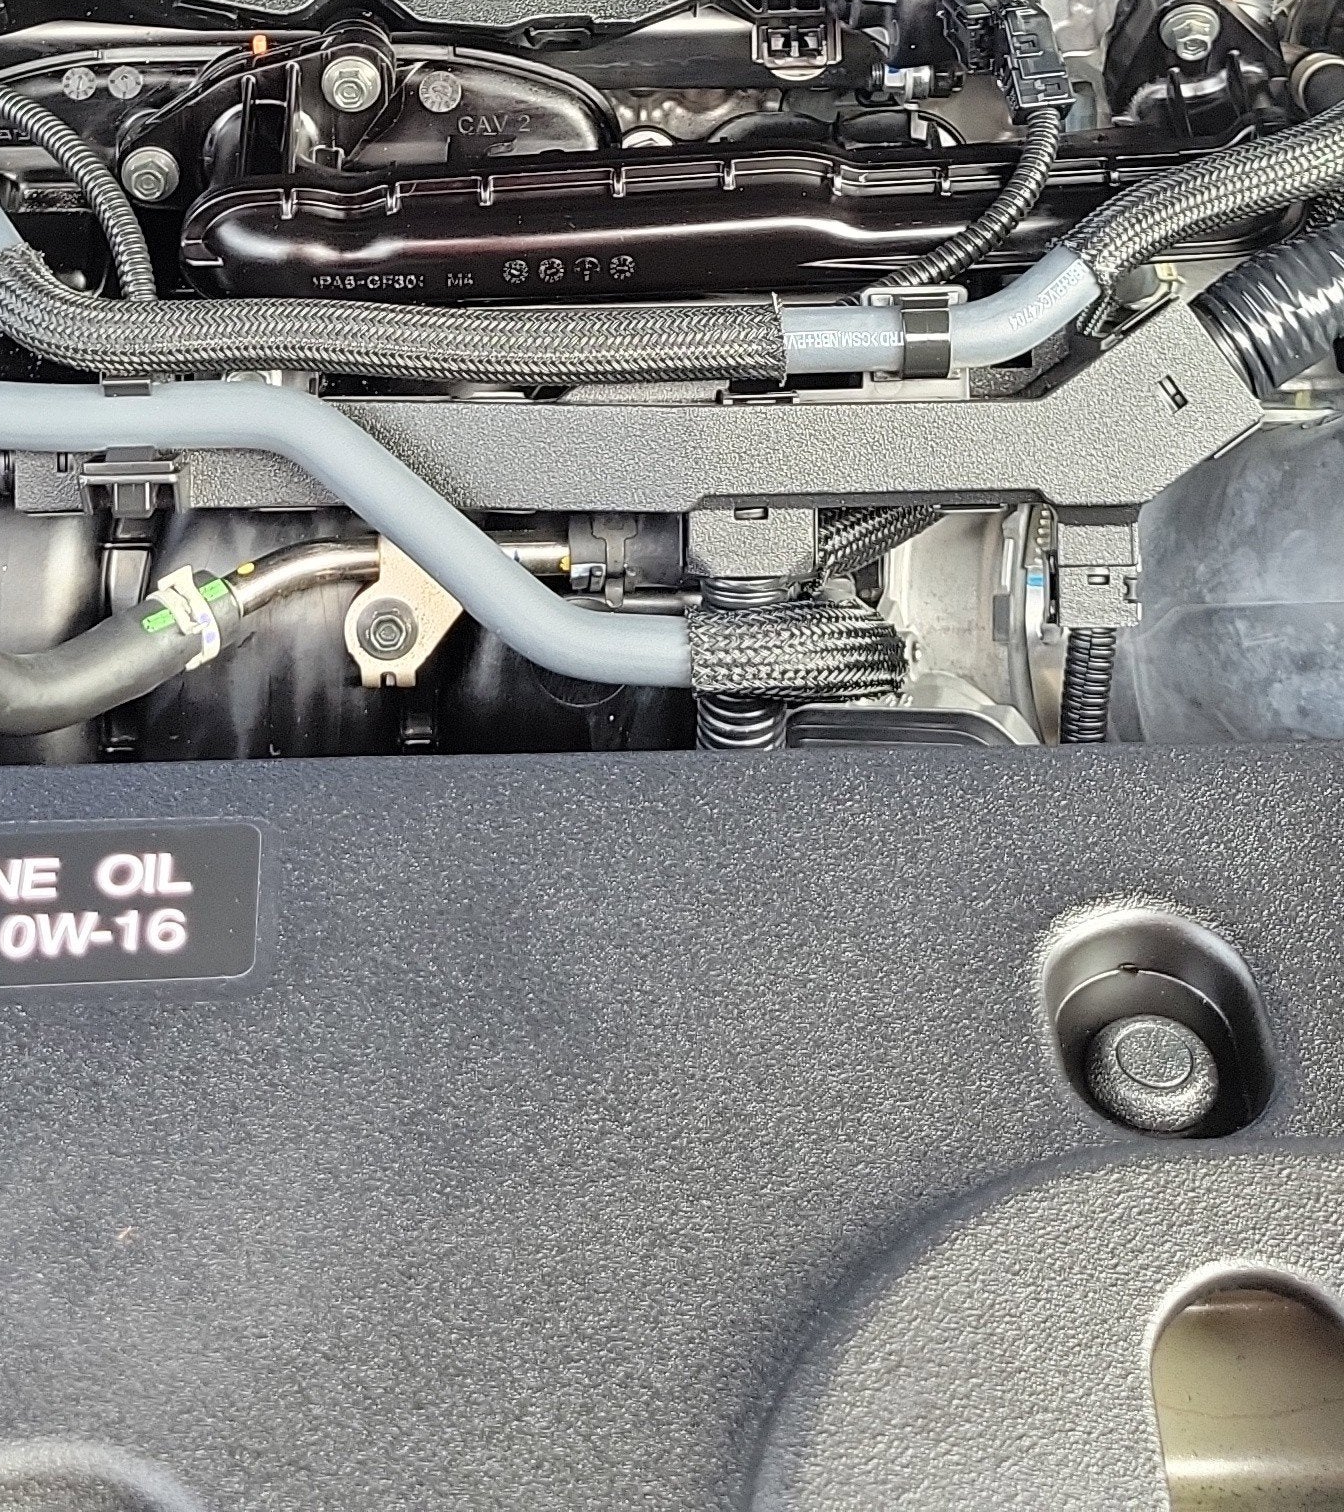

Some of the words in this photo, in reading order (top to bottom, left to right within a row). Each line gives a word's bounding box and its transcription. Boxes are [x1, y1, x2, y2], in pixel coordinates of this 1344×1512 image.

[458, 114, 508, 136] CAV
[518, 114, 531, 132] 2
[95, 852, 193, 896] OIL
